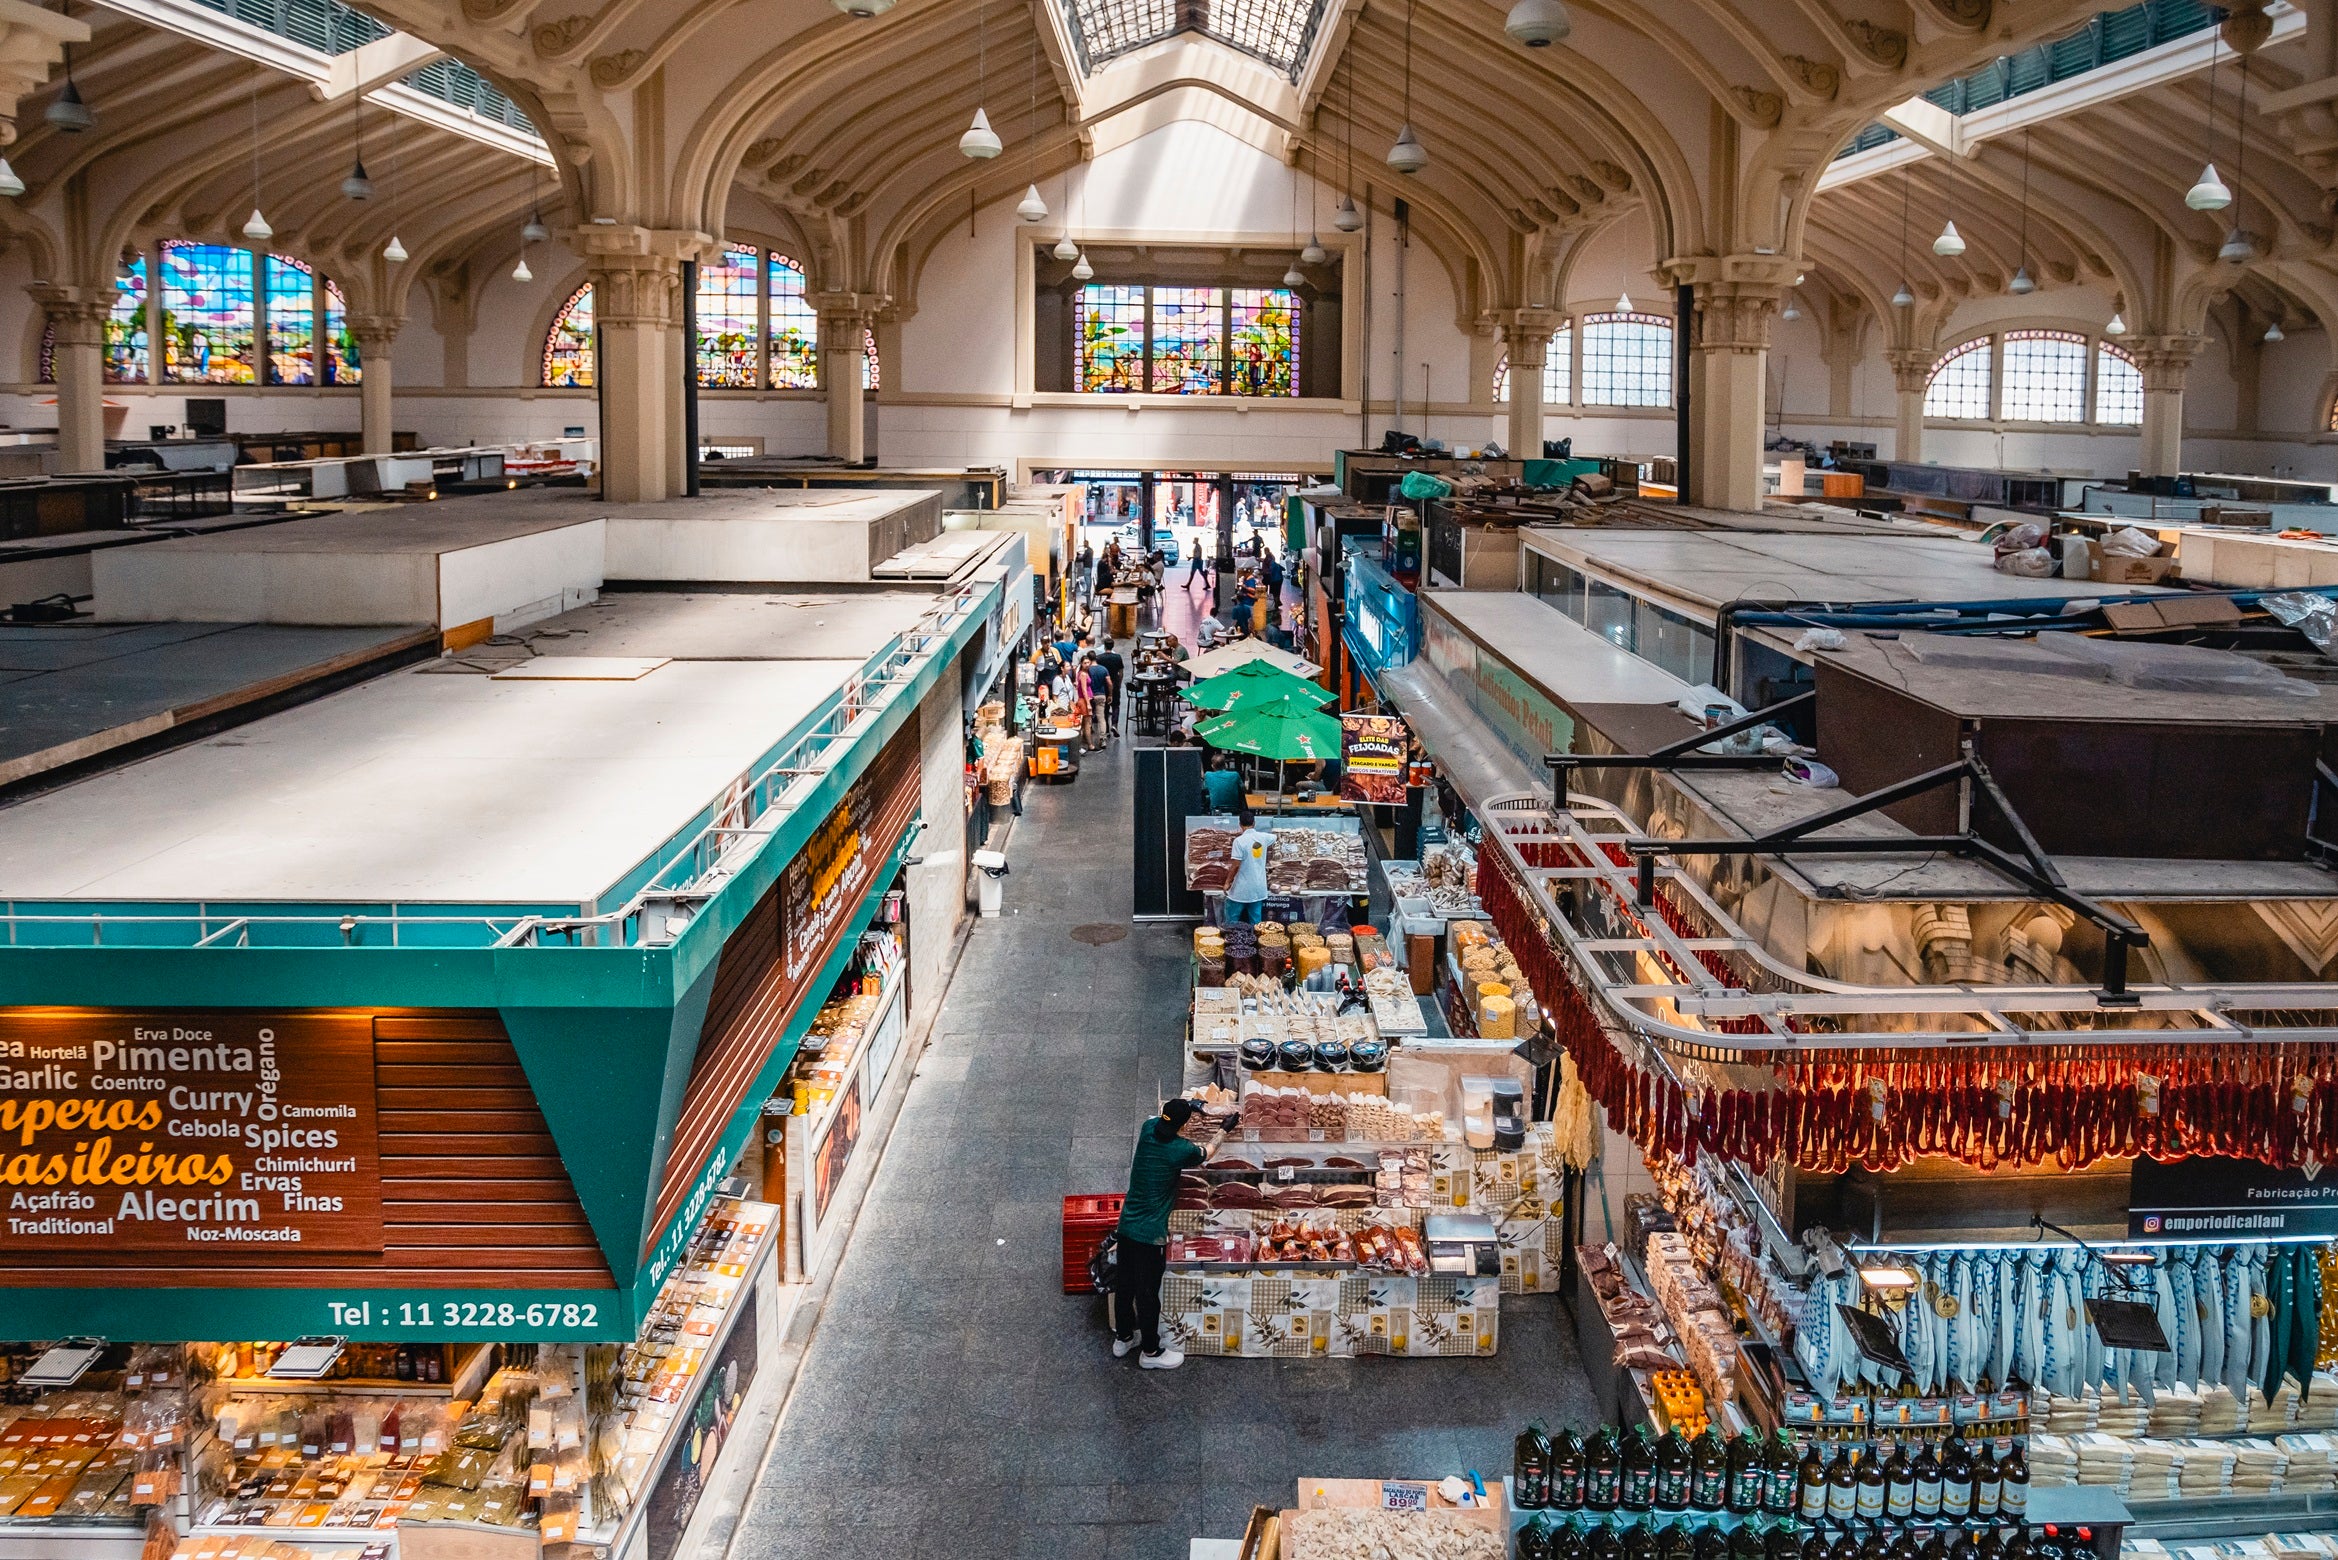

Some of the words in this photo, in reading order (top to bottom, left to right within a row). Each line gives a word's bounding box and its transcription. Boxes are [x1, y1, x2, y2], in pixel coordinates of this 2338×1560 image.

[1348, 743, 1400, 755] FEIJOADAS
[134, 1028, 168, 1041] Erva
[173, 1028, 212, 1041] Doce
[30, 1046, 87, 1060] Hortelã
[93, 1039, 253, 1072] Pimenta
[0, 1064, 78, 1090] Garlic
[91, 1075, 166, 1091] Coentro
[256, 1028, 281, 1121] Orégano
[168, 1086, 253, 1116] Curry
[282, 1104, 357, 1118] Camomila
[167, 1119, 241, 1138] Cebola
[245, 1123, 339, 1153] Spices
[255, 1157, 356, 1173] Chimichurri
[241, 1172, 302, 1192] Ervas
[10, 1190, 95, 1214] Açafrão
[284, 1192, 344, 1212] Finas
[671, 1219, 684, 1253] 11
[684, 1146, 728, 1231] 3228-6782
[2247, 1187, 2319, 1200] Fabricação
[117, 1189, 261, 1222] Alecrim
[8, 1217, 114, 1235] Traditional
[2164, 1214, 2285, 1231] emporiodicallani
[187, 1225, 301, 1242] Noz-Moscada
[328, 1301, 370, 1325] Tel
[400, 1302, 434, 1325] 11
[443, 1302, 598, 1326] 3228-6782
